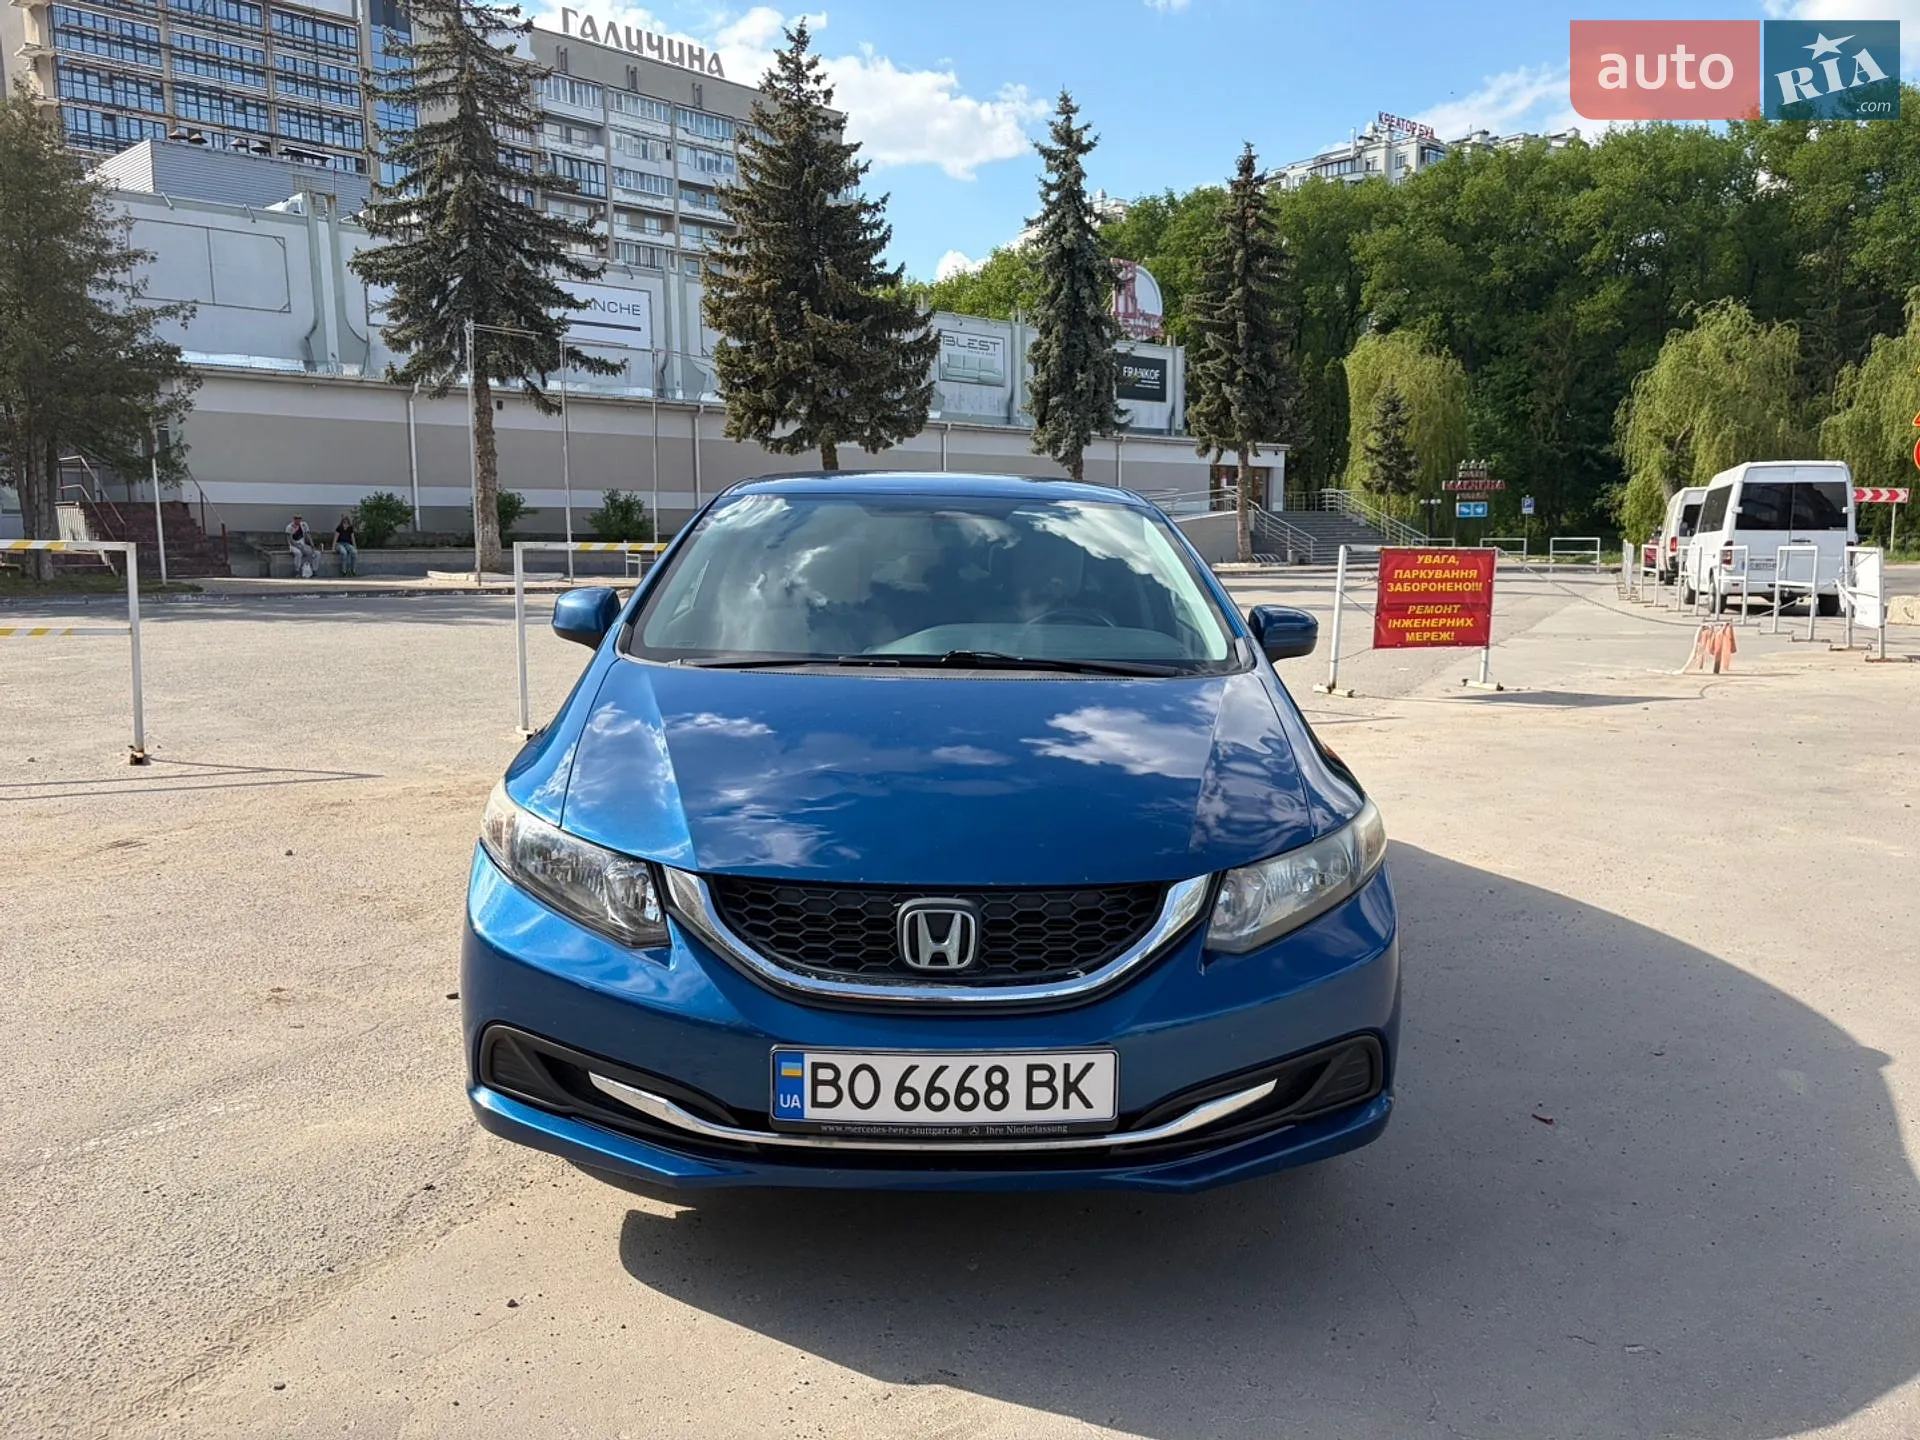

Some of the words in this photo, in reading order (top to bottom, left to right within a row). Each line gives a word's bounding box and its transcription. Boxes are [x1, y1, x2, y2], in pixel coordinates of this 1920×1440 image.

[562, 7, 725, 78] ГАЛИЧИНА
[588, 300, 641, 316] NCHE
[942, 335, 1000, 352] BLEST
[1416, 555, 1459, 566] УВАГА,
[1393, 569, 1477, 579] ПАРКУВАННЯ
[1387, 582, 1482, 592] ЗАБОРОНЕНО!!!
[1408, 604, 1461, 614] РЕМОНТ
[1388, 618, 1473, 628] ІНЖЕНЕРНИХ
[1405, 631, 1455, 642] МЕРЕЖ!
[779, 1093, 801, 1109] UA
[810, 1061, 881, 1110] BO
[894, 1064, 1010, 1112] 6668
[1026, 1062, 1095, 1111] BK
[986, 1125, 1003, 1135] Ihre
[1006, 1125, 1068, 1135] Niederlassung
